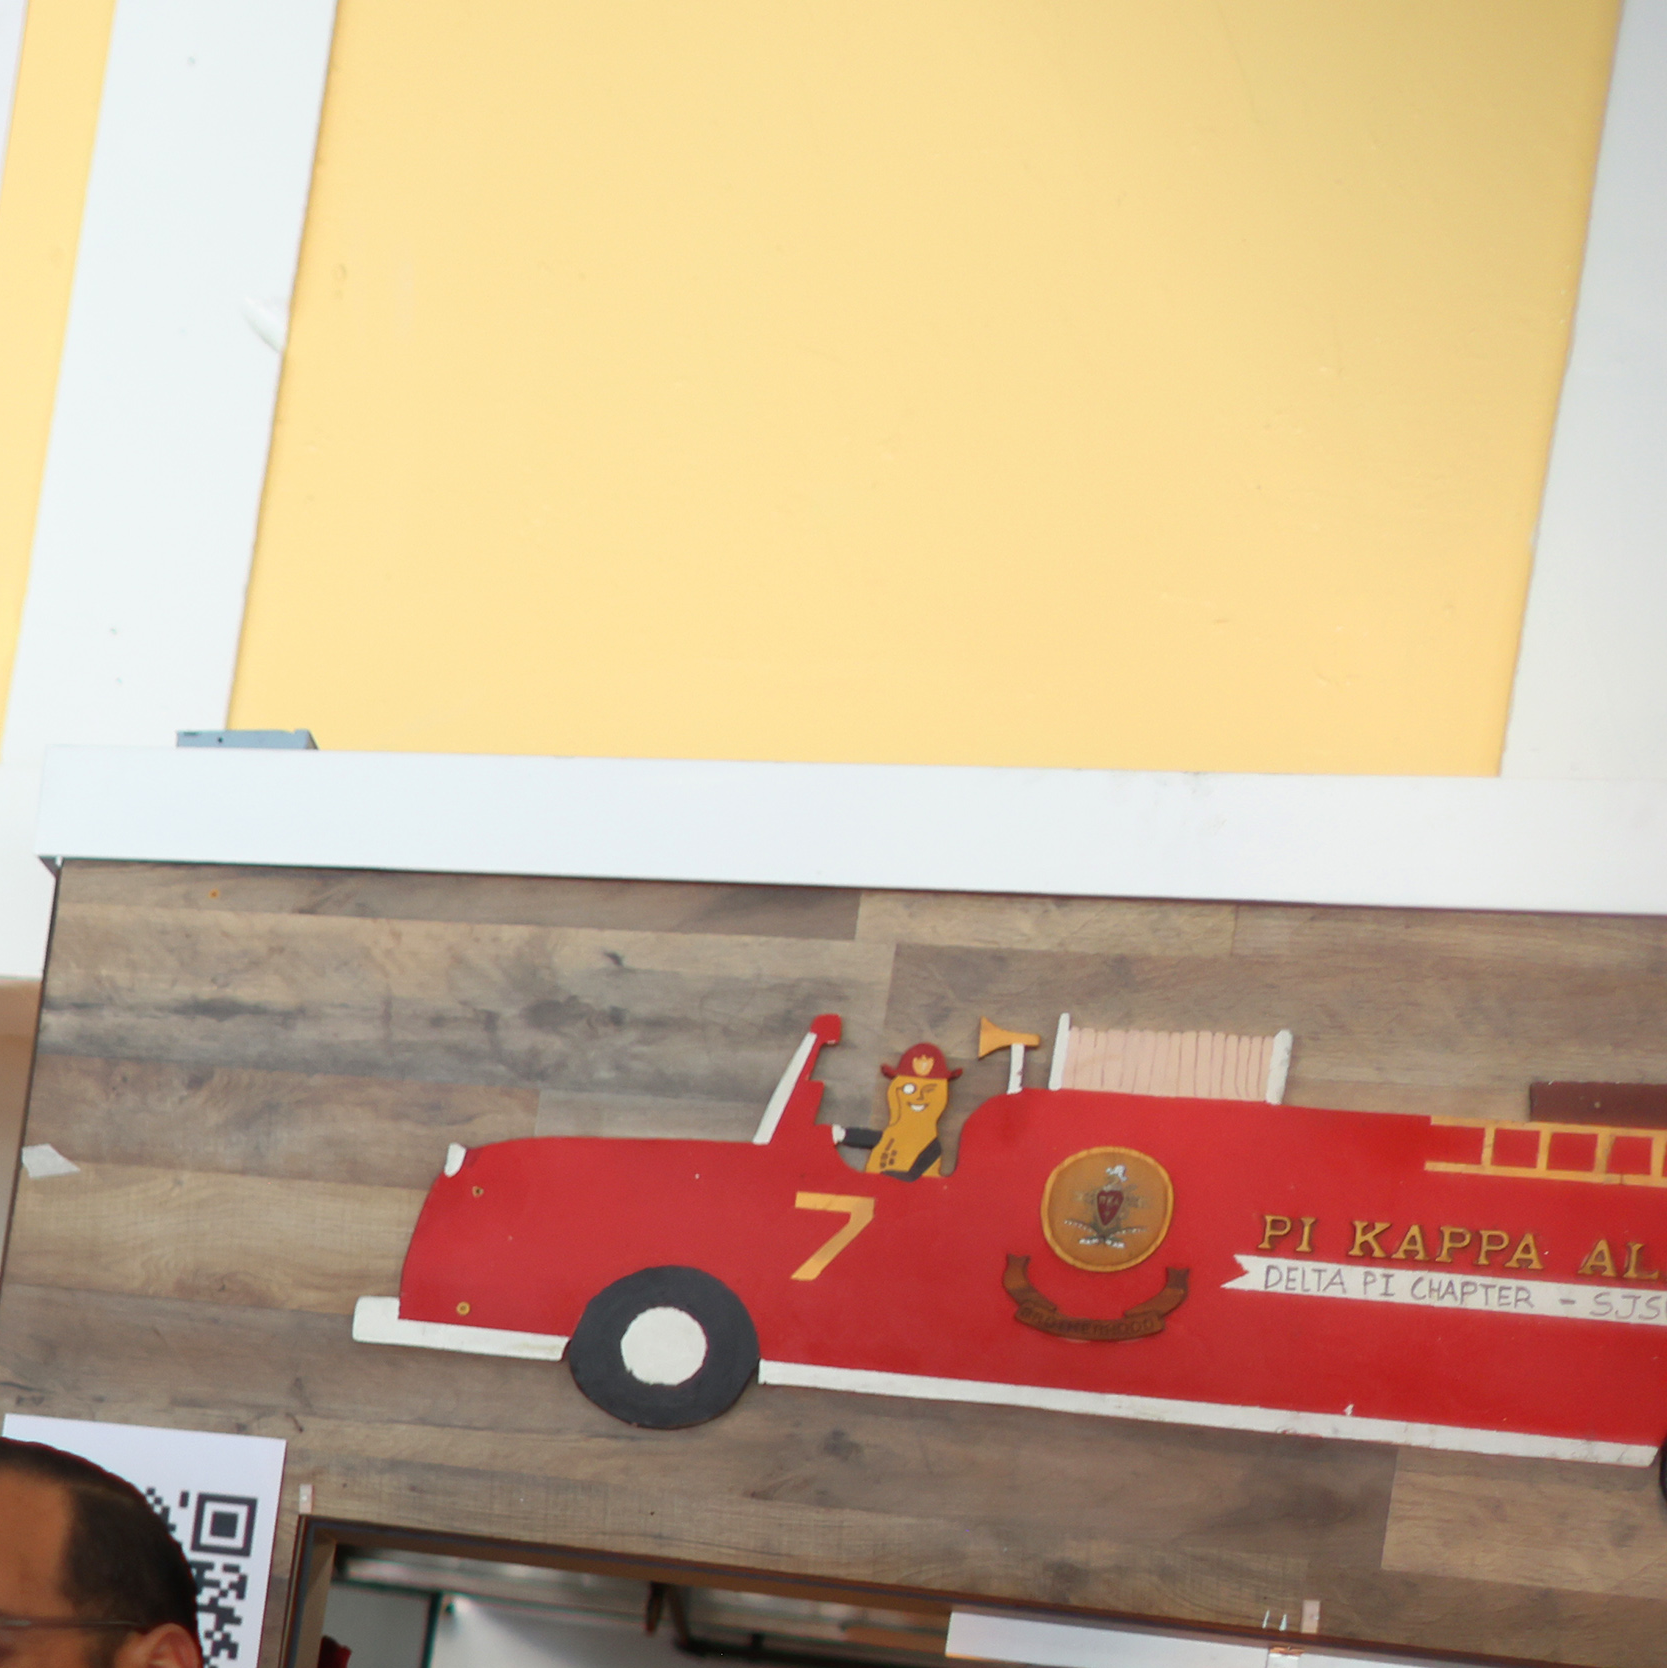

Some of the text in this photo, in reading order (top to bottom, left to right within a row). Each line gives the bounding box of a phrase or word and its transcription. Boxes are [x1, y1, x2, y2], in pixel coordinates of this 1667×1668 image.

[790, 1191, 876, 1281] 7
[1258, 1214, 1665, 1281] PI KAPPA AL
[1263, 1264, 1347, 1295] DELTA
[1363, 1270, 1396, 1297] PI
[1409, 1276, 1535, 1310] CHAPTER
[1589, 1291, 1667, 1321] SJS
